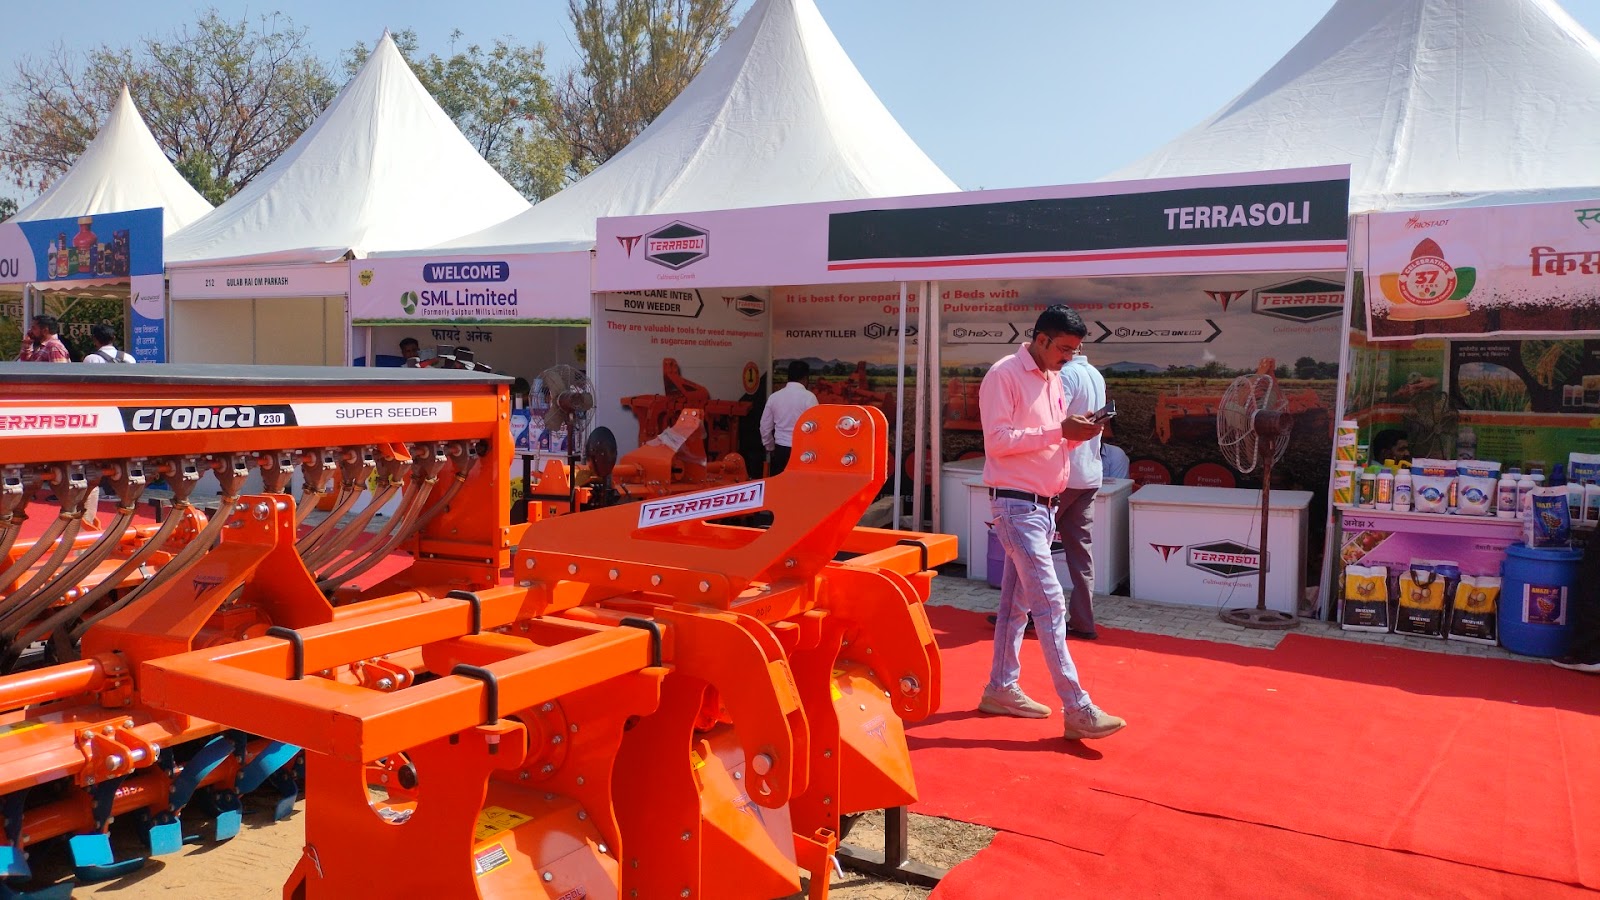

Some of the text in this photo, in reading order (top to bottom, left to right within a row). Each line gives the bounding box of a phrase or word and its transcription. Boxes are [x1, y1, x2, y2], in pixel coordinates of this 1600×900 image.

[1164, 201, 1310, 230] TERRASOLI
[1413, 219, 1450, 229] BIOSTADT
[650, 239, 704, 251] TERRASOLI
[1405, 258, 1448, 274] CELEBRATING
[432, 265, 501, 280] WELCOME
[1415, 270, 1440, 284] 37
[205, 279, 215, 287] 212
[226, 278, 243, 287] GULAB
[264, 277, 288, 286] PARKASH
[421, 288, 518, 306] SML Limited
[644, 289, 668, 298] CANE
[669, 291, 693, 301] INTER
[786, 294, 795, 303] It
[798, 294, 808, 303] is
[811, 294, 836, 303] best
[838, 293, 856, 303] for
[858, 292, 917, 304] preparig
[954, 290, 985, 299] Beds
[990, 289, 1020, 299] with
[1261, 294, 1345, 306] TERRASO
[624, 299, 681, 312] ROW WEEDER
[943, 303, 1030, 312] Pulverization
[1108, 301, 1154, 312] crops.
[421, 308, 518, 317] (Formerly Sulphur Mills Limited)
[431, 325, 492, 344] फायदे अनेक
[607, 321, 627, 332] They
[644, 324, 675, 333] valuable
[696, 327, 706, 335] for
[708, 328, 725, 336] weed
[786, 329, 823, 339] ROTARY
[825, 329, 857, 338] TILLER
[1273, 325, 1311, 335] Cultivating
[651, 336, 733, 349] in sugarcane cultivation
[748, 368, 754, 383] 1
[335, 407, 437, 419] SUPER SEEDER
[263, 415, 281, 424] 230
[1138, 465, 1155, 473] Bold
[1197, 476, 1222, 485] French
[648, 489, 757, 520] TERRASOLI
[1193, 551, 1259, 565] TERRASOL
[1202, 578, 1253, 589] Cultivating Growth
